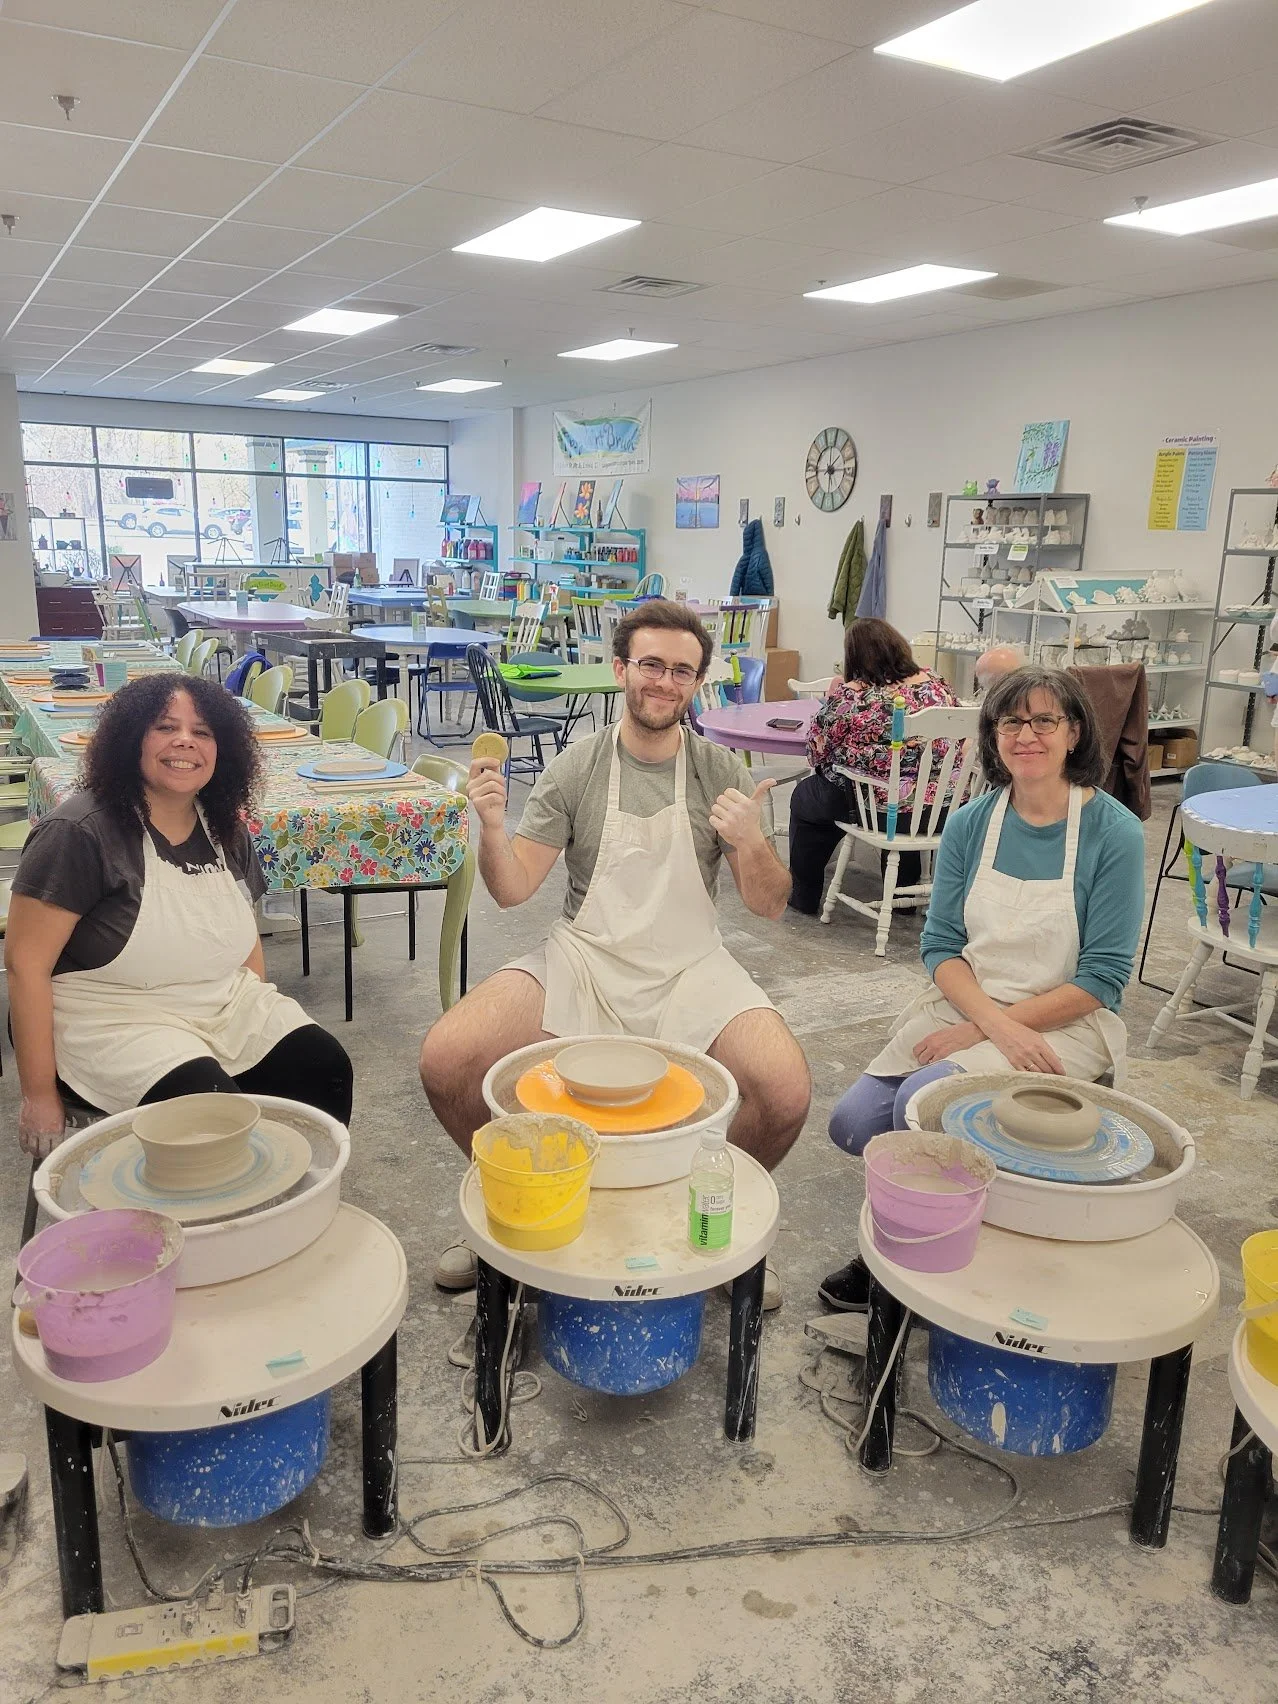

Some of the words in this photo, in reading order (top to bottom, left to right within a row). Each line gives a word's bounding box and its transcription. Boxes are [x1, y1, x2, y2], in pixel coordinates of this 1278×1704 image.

[1165, 436, 1188, 444] Ceramic
[1189, 434, 1214, 444] Painting
[612, 1285, 664, 1297] Nidec
[992, 1331, 1052, 1354] Nidec
[217, 1394, 282, 1420] Nidec
